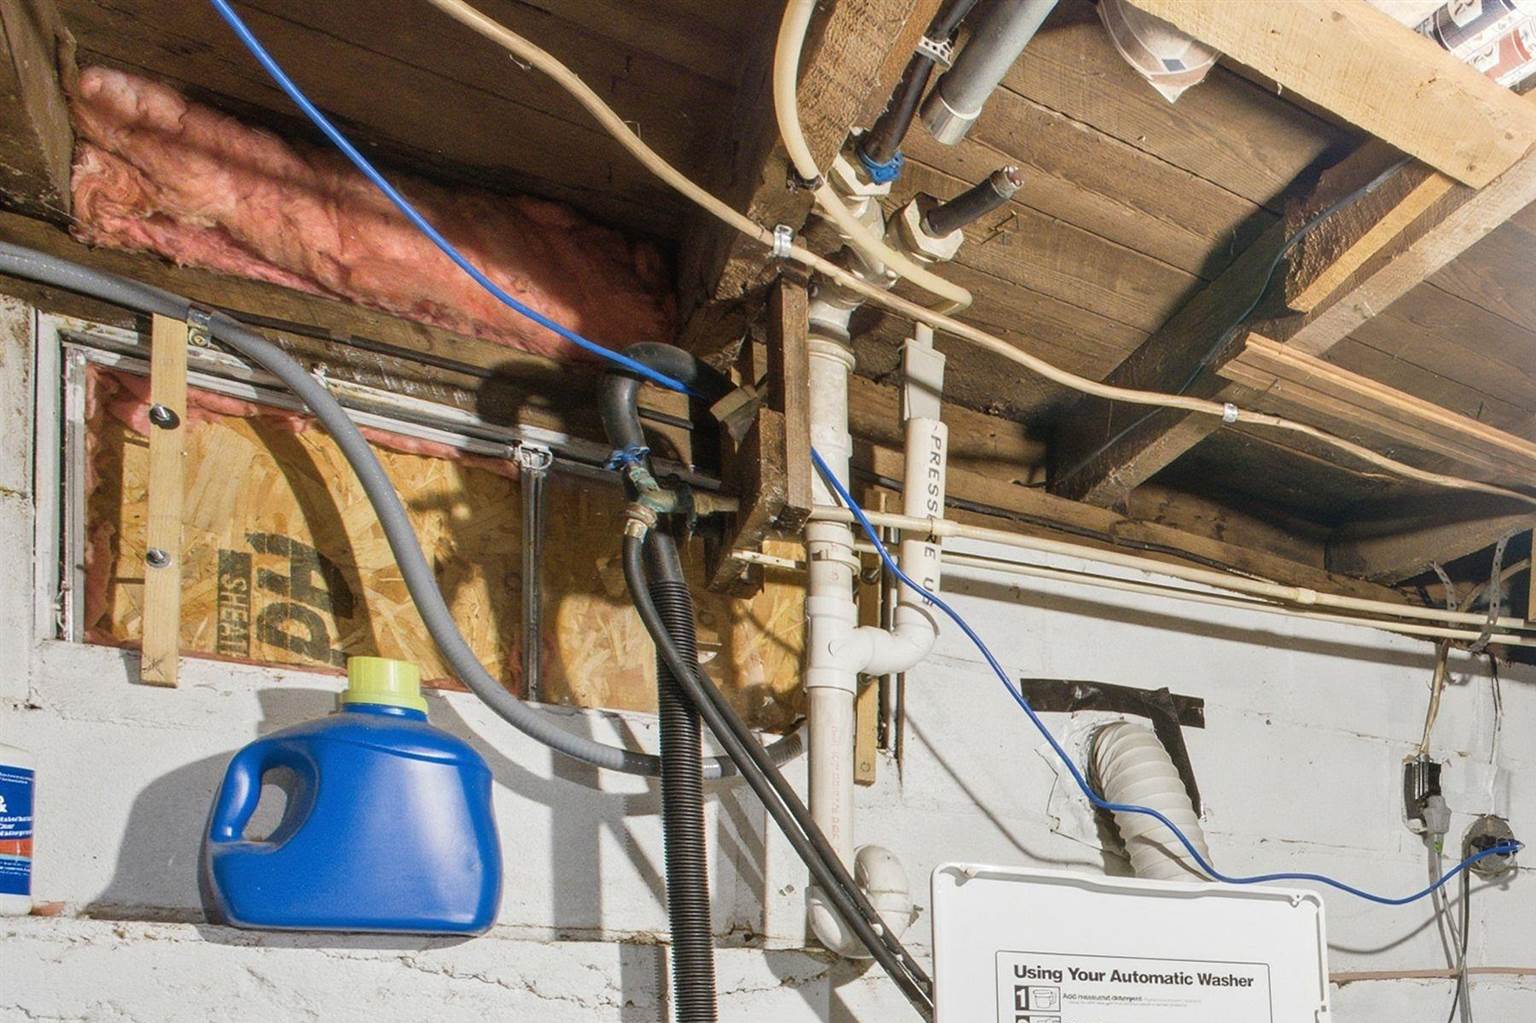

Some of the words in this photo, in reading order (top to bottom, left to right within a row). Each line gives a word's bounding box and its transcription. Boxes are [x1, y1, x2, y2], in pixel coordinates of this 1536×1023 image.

[1014, 964, 1063, 983] Using
[1068, 967, 1106, 982] Your
[1110, 969, 1194, 986] Automatic
[1197, 972, 1254, 988] Washer
[1016, 988, 1026, 1009] 1
